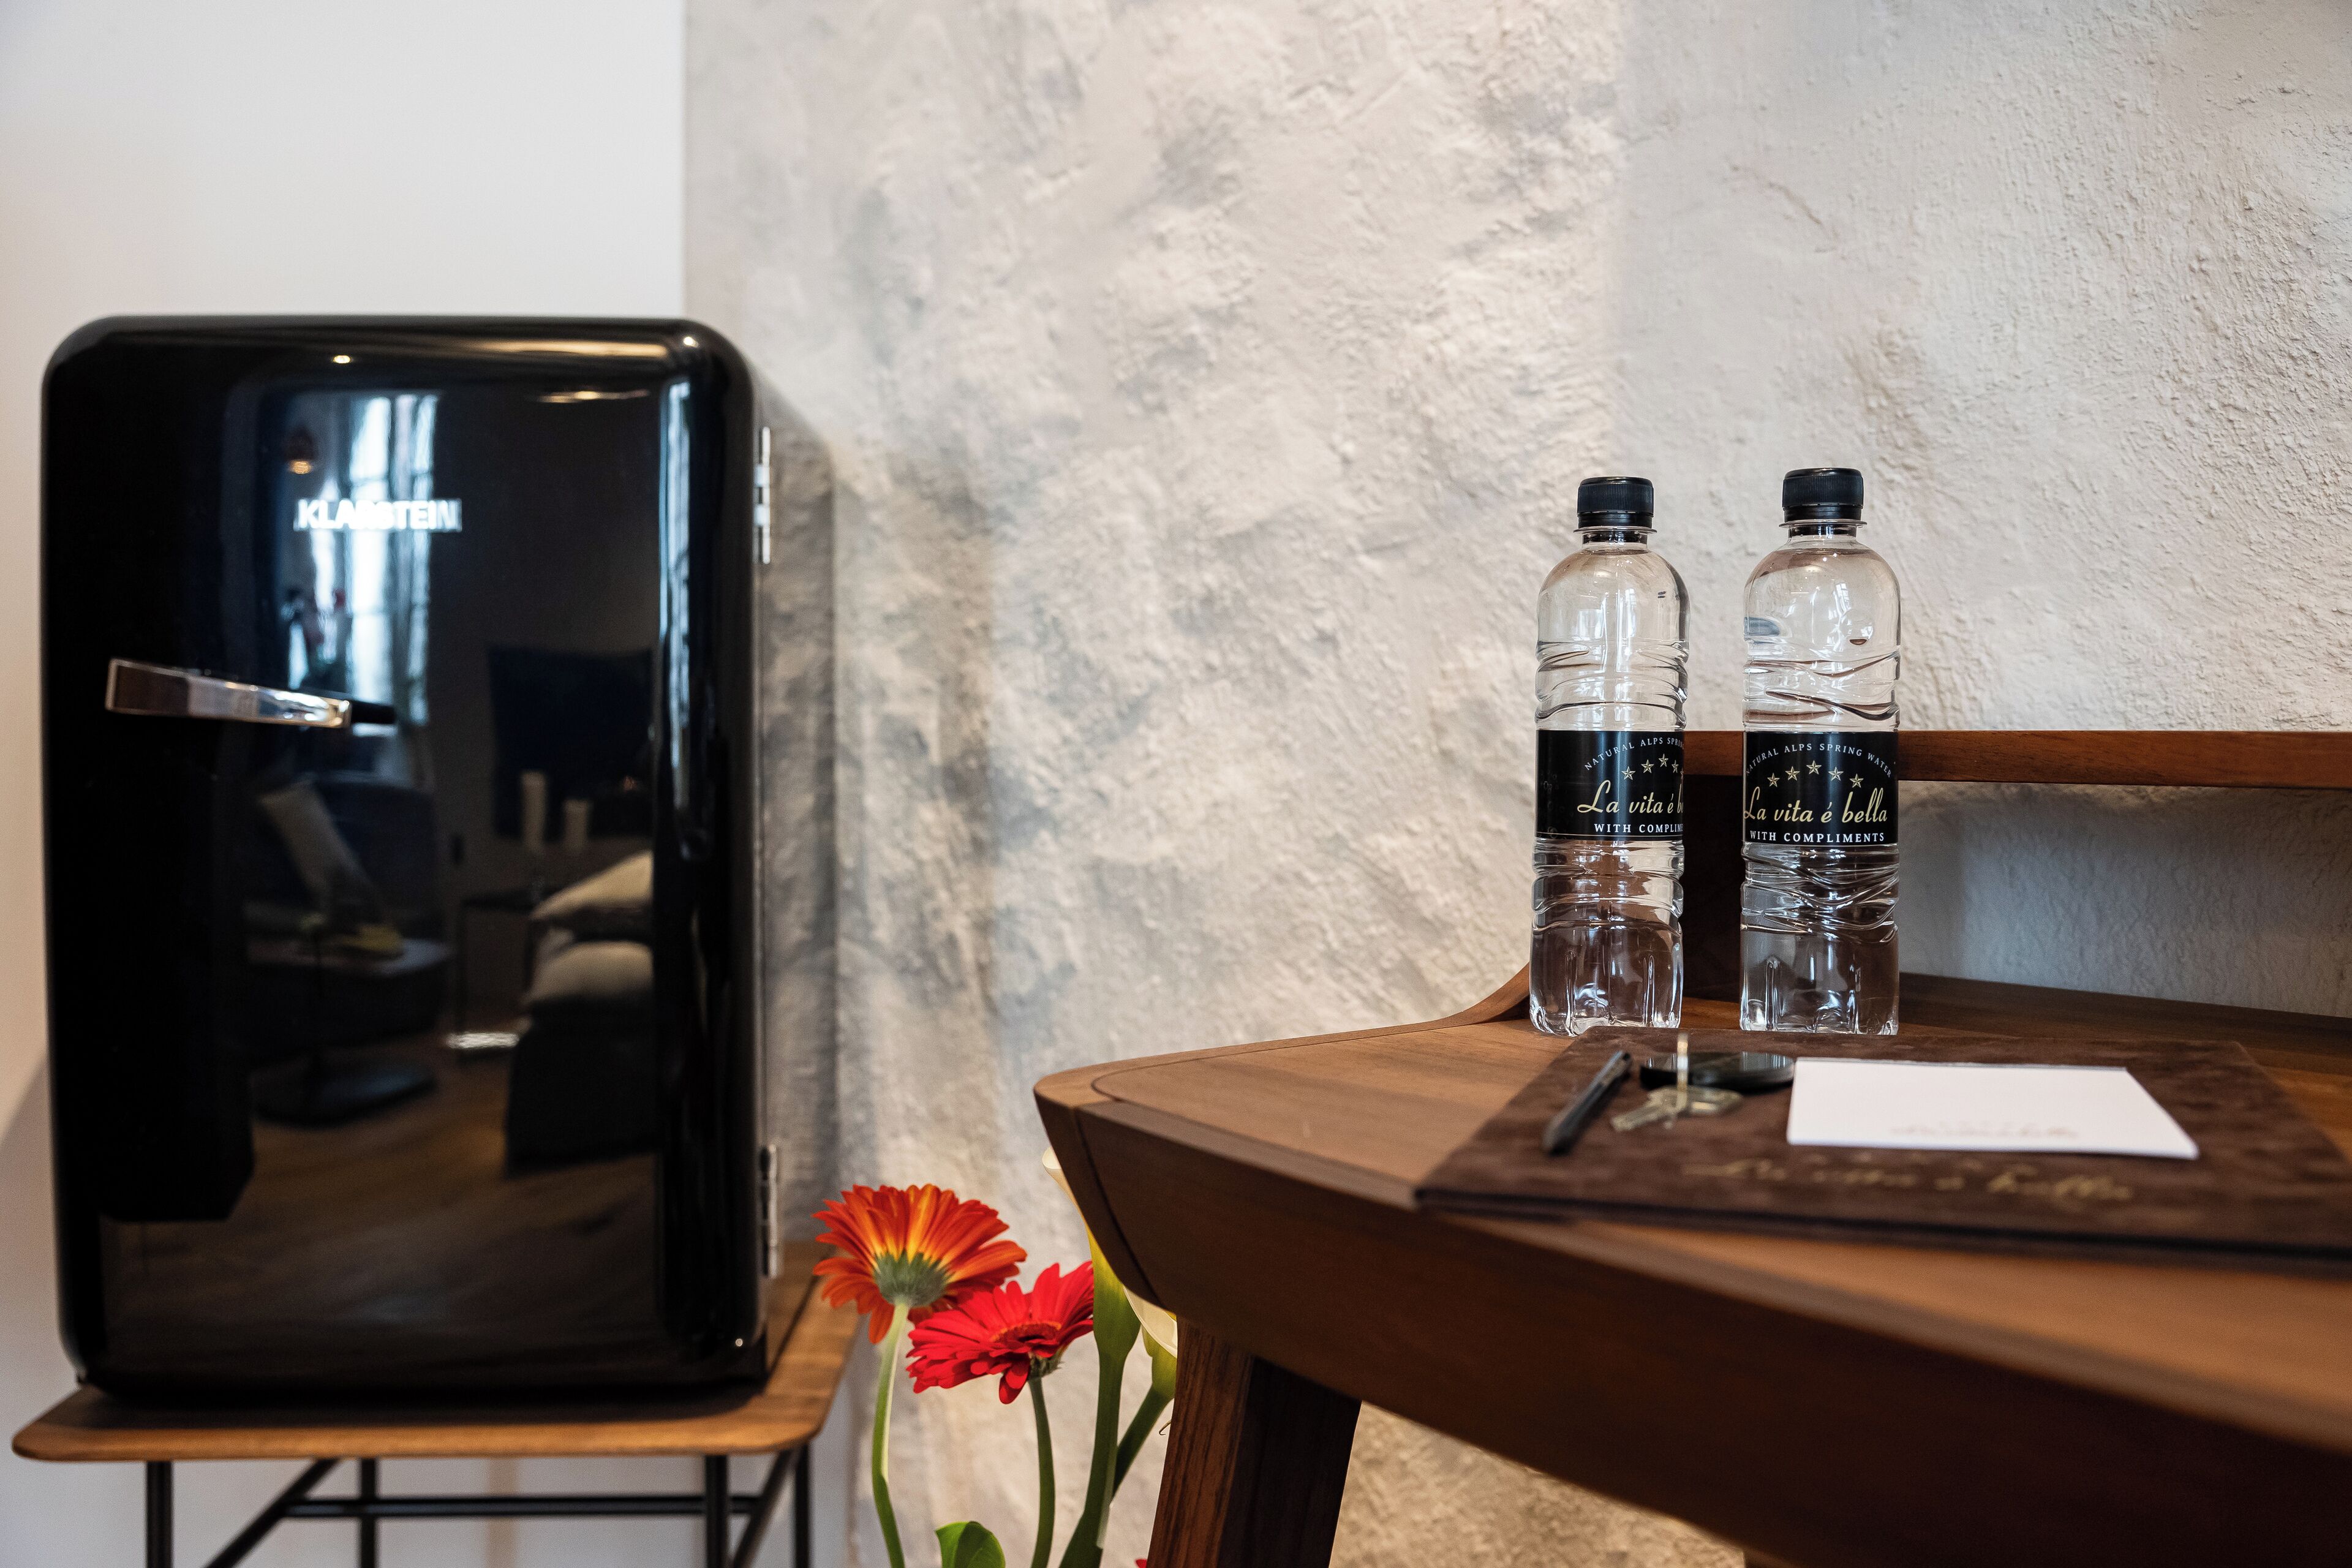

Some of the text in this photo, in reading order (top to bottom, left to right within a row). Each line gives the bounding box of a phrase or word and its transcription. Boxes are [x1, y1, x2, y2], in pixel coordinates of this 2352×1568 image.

[1585, 742, 1634, 771] NATURAL
[1640, 737, 1664, 747] ALPS
[1746, 743, 1891, 778] NATURAL ALPS SPRING WATER
[1577, 780, 1619, 813] La
[1629, 792, 1664, 813] vita
[1744, 786, 1888, 823] La vita é bella
[1594, 823, 1632, 833] WITH
[1750, 830, 1885, 843] WITH COMPLIMENTS
